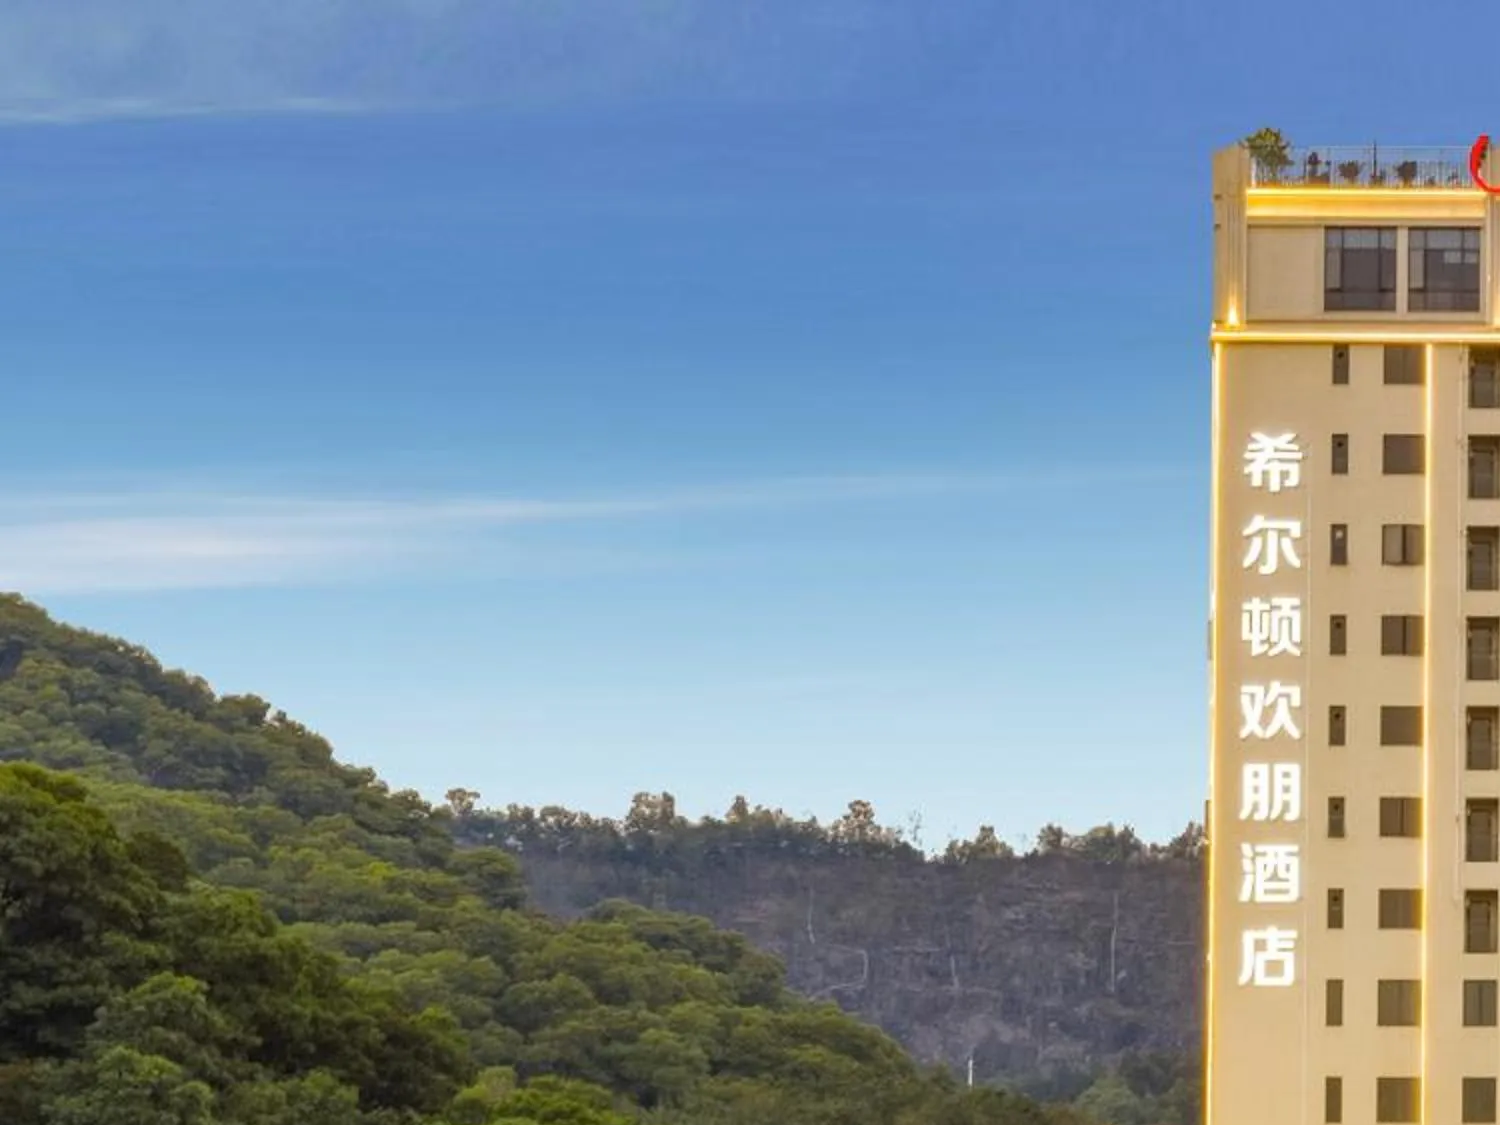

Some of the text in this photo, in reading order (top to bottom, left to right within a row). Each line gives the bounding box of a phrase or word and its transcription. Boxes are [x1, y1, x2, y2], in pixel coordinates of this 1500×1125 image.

[1239, 431, 1303, 988] 希尔顿欢朋酒店
